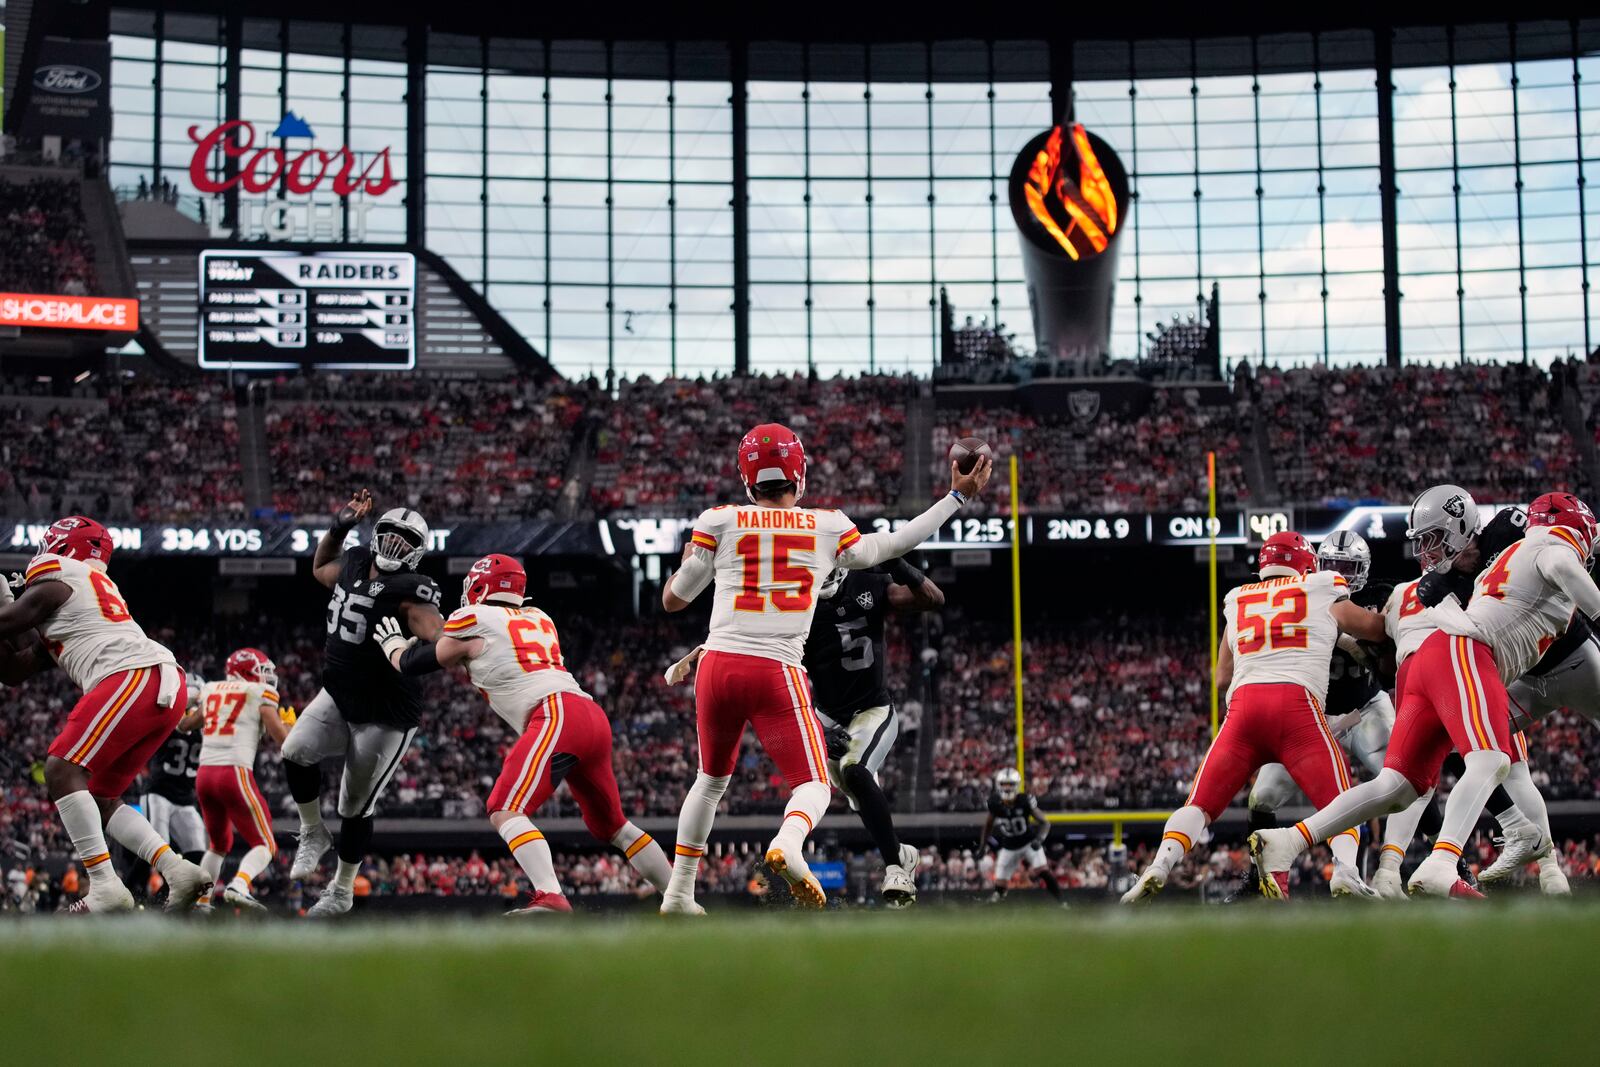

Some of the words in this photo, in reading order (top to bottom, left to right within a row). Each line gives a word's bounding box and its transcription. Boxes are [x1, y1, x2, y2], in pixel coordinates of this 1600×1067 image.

[188, 120, 400, 196] Coors
[209, 200, 376, 243] LIGHT
[299, 263, 399, 279] RAIDERS
[162, 528, 209, 549] 334
[215, 529, 262, 550] YDS
[291, 529, 309, 551] 3
[737, 510, 816, 529] MAHOMES
[1047, 518, 1091, 540] 2ND
[1094, 518, 1111, 539] &
[1114, 518, 1130, 538] 9
[1169, 517, 1203, 538] ON
[733, 532, 817, 613] 15
[1236, 587, 1309, 655] 52
[835, 616, 875, 671] 5
[203, 692, 247, 736] 87
[163, 738, 200, 778] 39
